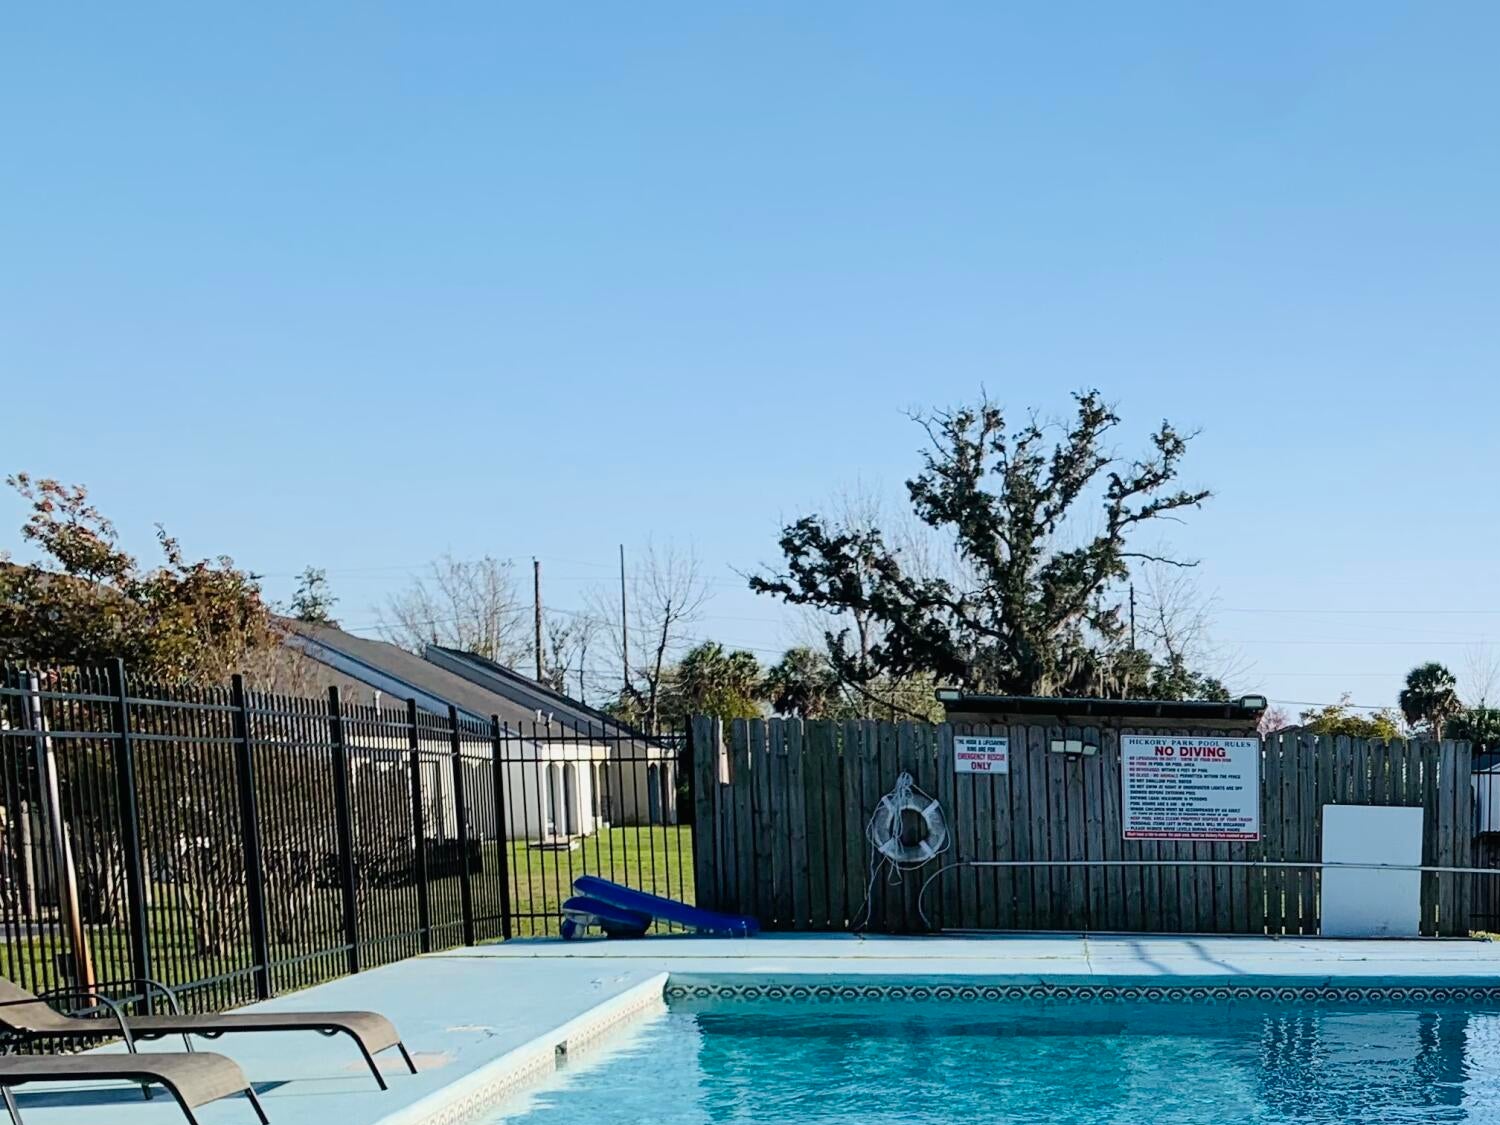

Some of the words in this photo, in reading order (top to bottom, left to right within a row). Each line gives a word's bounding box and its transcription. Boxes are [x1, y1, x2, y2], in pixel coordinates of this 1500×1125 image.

[1154, 746, 1174, 756] NO
[1180, 747, 1226, 757] DIVING
[971, 761, 991, 770] ONLY
